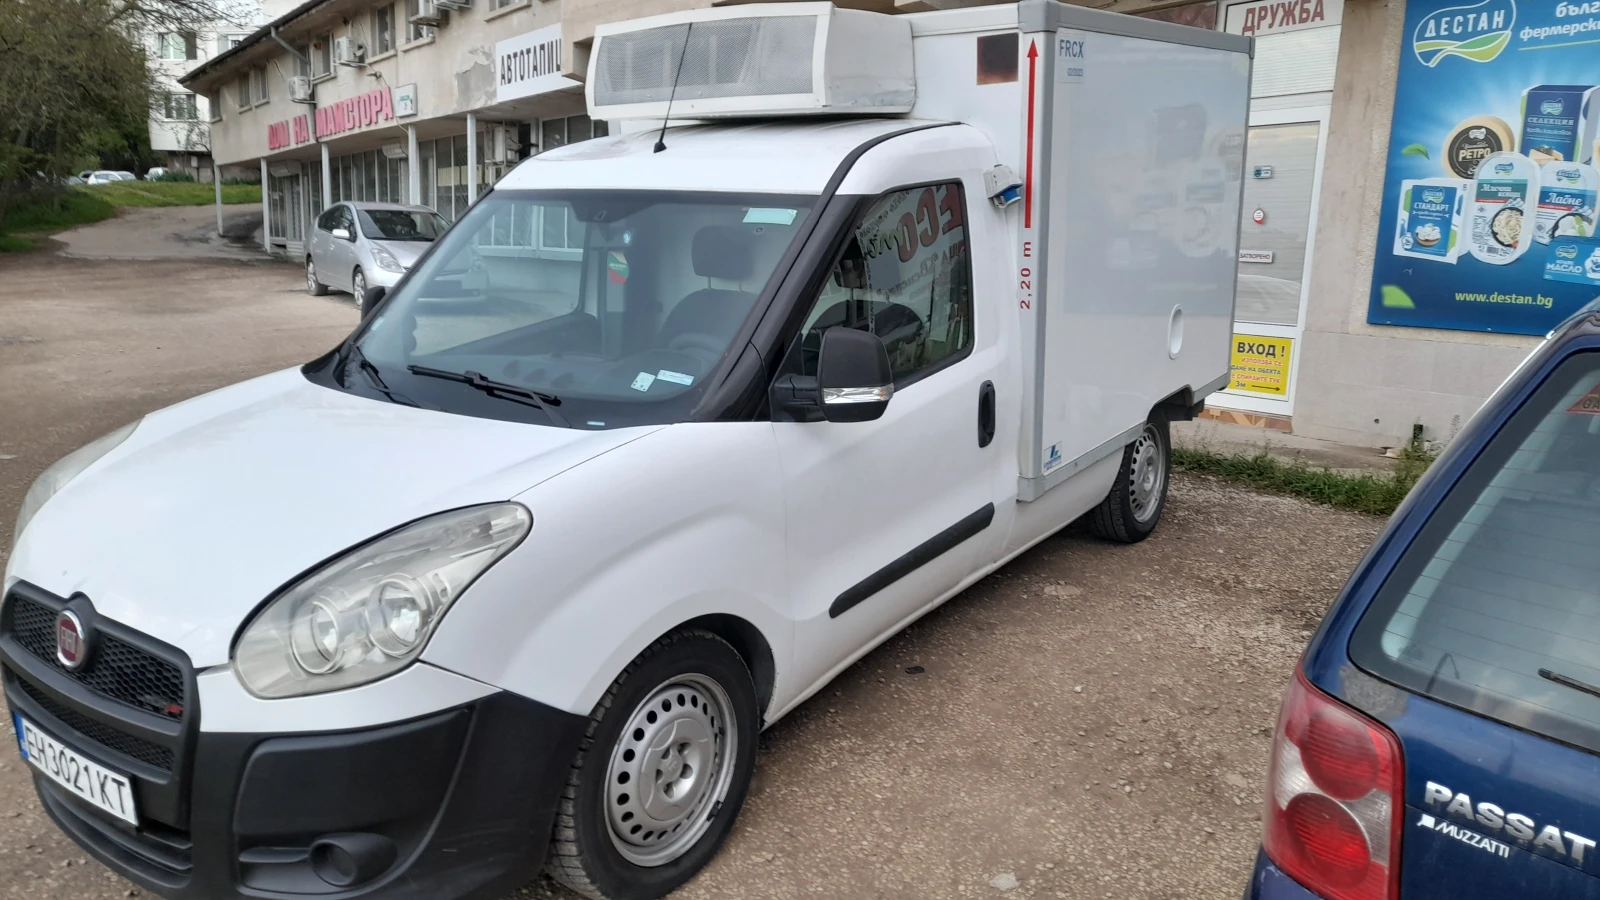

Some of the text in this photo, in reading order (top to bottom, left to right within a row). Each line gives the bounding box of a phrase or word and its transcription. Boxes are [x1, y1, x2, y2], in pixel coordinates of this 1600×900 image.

[1242, 0, 1325, 36] ДРУЖБА
[1424, 10, 1505, 38] ДЕСТАН
[1059, 39, 1084, 58] FRCX
[1527, 116, 1575, 125] СЕЛЕКЦИЯ
[268, 119, 290, 150] ДОМ
[292, 113, 310, 144] НА
[1458, 148, 1491, 161] РЕТРО
[1414, 201, 1450, 212] СТАНДАРТ
[1239, 252, 1271, 260] ЗАТВОРЕНО
[1020, 241, 1033, 310] 2,20 m
[1546, 262, 1583, 274] МАСЛО
[1455, 291, 1554, 309] www.destan.bg
[1237, 341, 1276, 359] ВХОД
[24, 724, 128, 815] EH3021KT
[1424, 780, 1597, 863] PASSAT
[1434, 821, 1510, 859] MUZZATTI
